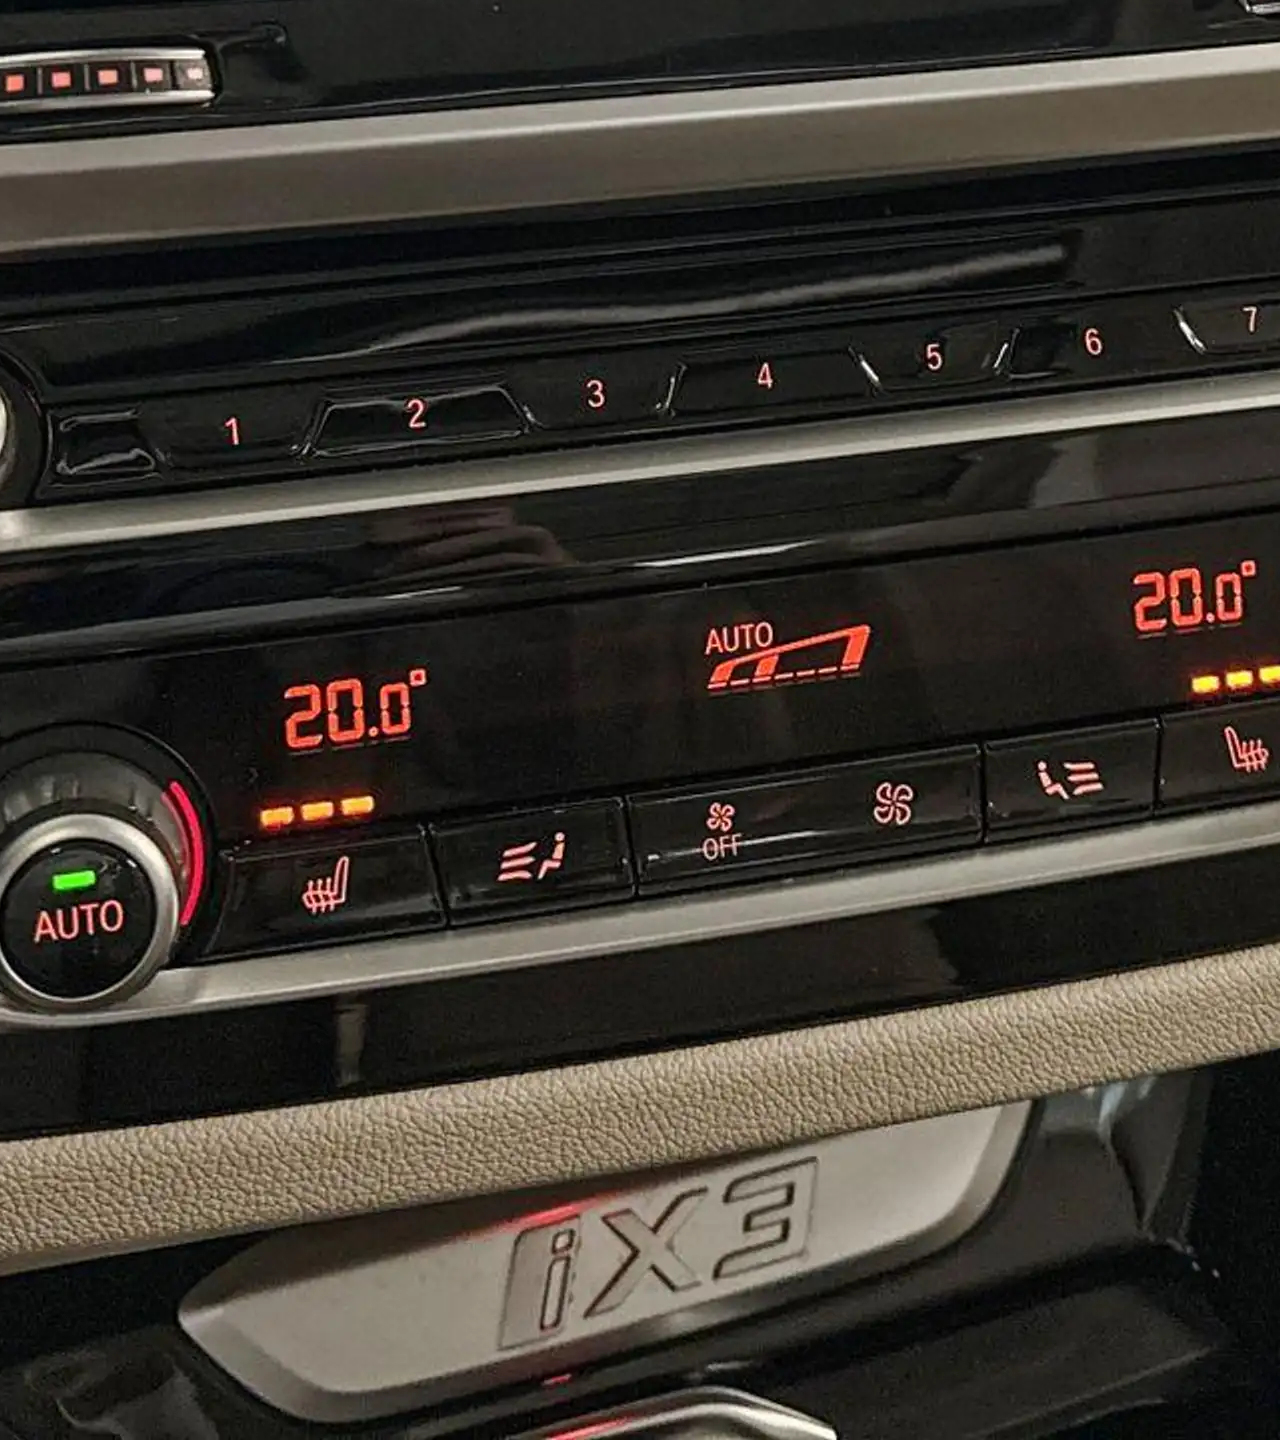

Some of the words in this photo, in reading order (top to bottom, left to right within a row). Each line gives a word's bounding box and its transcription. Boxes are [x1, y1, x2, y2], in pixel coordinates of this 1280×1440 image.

[224, 416, 242, 446] 1
[407, 399, 426, 429] 2
[586, 379, 606, 408] 3
[756, 363, 773, 391] 4
[925, 343, 944, 372] 5
[1084, 327, 1104, 356] 6
[1243, 306, 1261, 334] 7
[705, 621, 773, 656] AUTO
[702, 835, 743, 861] OFF
[33, 900, 123, 943] AUTO
